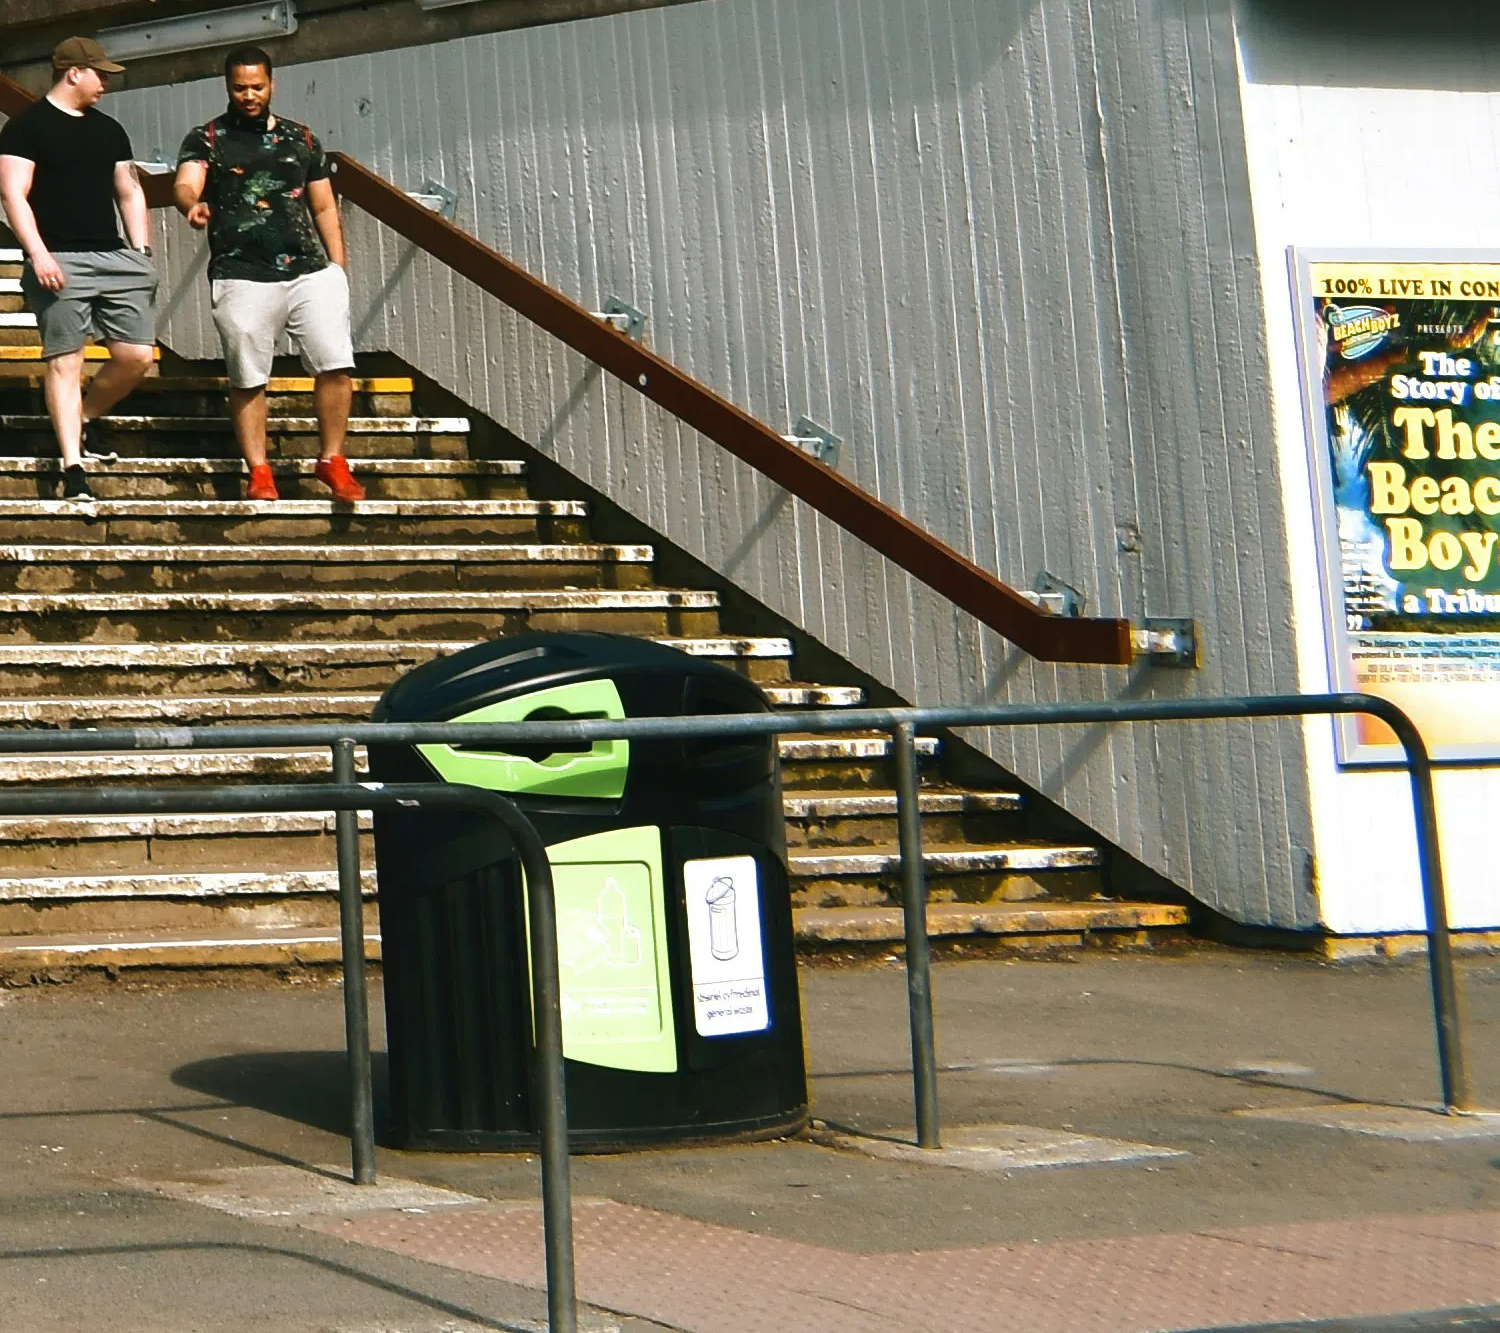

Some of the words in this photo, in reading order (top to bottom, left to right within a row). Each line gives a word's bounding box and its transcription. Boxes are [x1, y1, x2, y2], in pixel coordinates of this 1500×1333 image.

[1321, 278, 1373, 295] 100%
[1380, 279, 1425, 296] LIVE
[1430, 280, 1452, 296] IN
[1334, 316, 1371, 341] BEACH
[1420, 350, 1471, 376] The
[1391, 374, 1467, 405] Story
[1393, 407, 1500, 460] The
[1385, 517, 1500, 582] Boy
[1403, 594, 1420, 613] a
